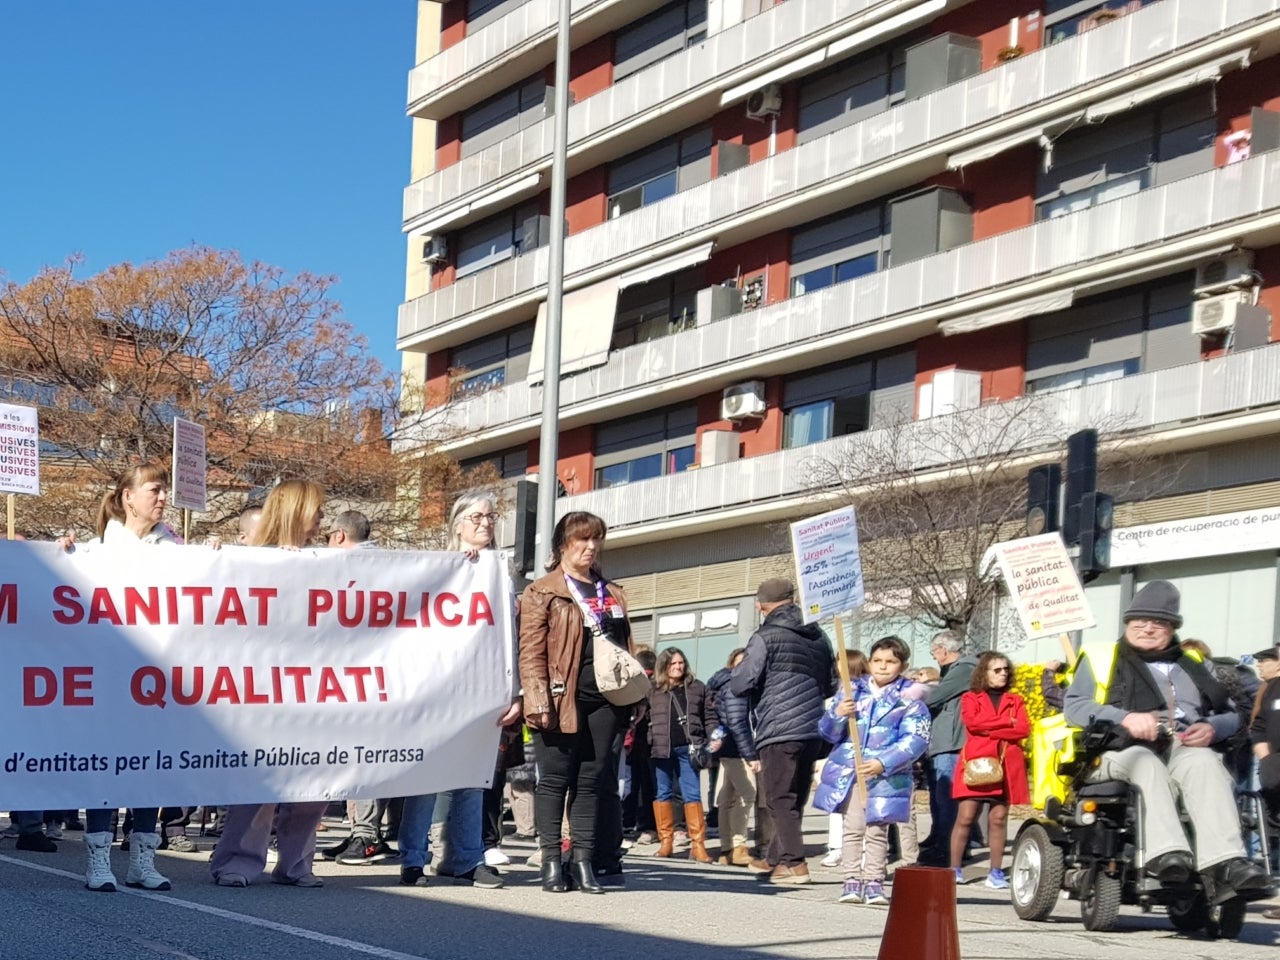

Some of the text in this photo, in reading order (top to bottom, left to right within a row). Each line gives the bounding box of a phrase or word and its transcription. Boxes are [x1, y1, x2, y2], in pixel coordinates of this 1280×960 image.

[10, 414, 20, 422] les
[798, 523, 823, 536] Sanitat
[1118, 528, 1154, 541] Centre
[1156, 527, 1170, 536] de
[1242, 514, 1258, 524] de
[803, 543, 835, 560] Urgent!
[802, 560, 829, 576] 25%
[1012, 569, 1021, 579] la
[808, 570, 856, 591] l'Assistència
[1016, 576, 1060, 596] pública
[52, 584, 278, 626] SANITAT
[307, 580, 494, 628] PÚBLICA
[1028, 593, 1080, 610] de Qualitat
[23, 666, 94, 706] DE
[130, 666, 388, 710] QUALITAT!
[5, 752, 108, 774] d'entitats
[115, 754, 150, 775] per
[156, 750, 172, 770] la
[178, 749, 248, 770] Sanitat
[254, 746, 320, 767] Pública
[326, 746, 348, 764] de
[354, 746, 424, 764] Terrassa
